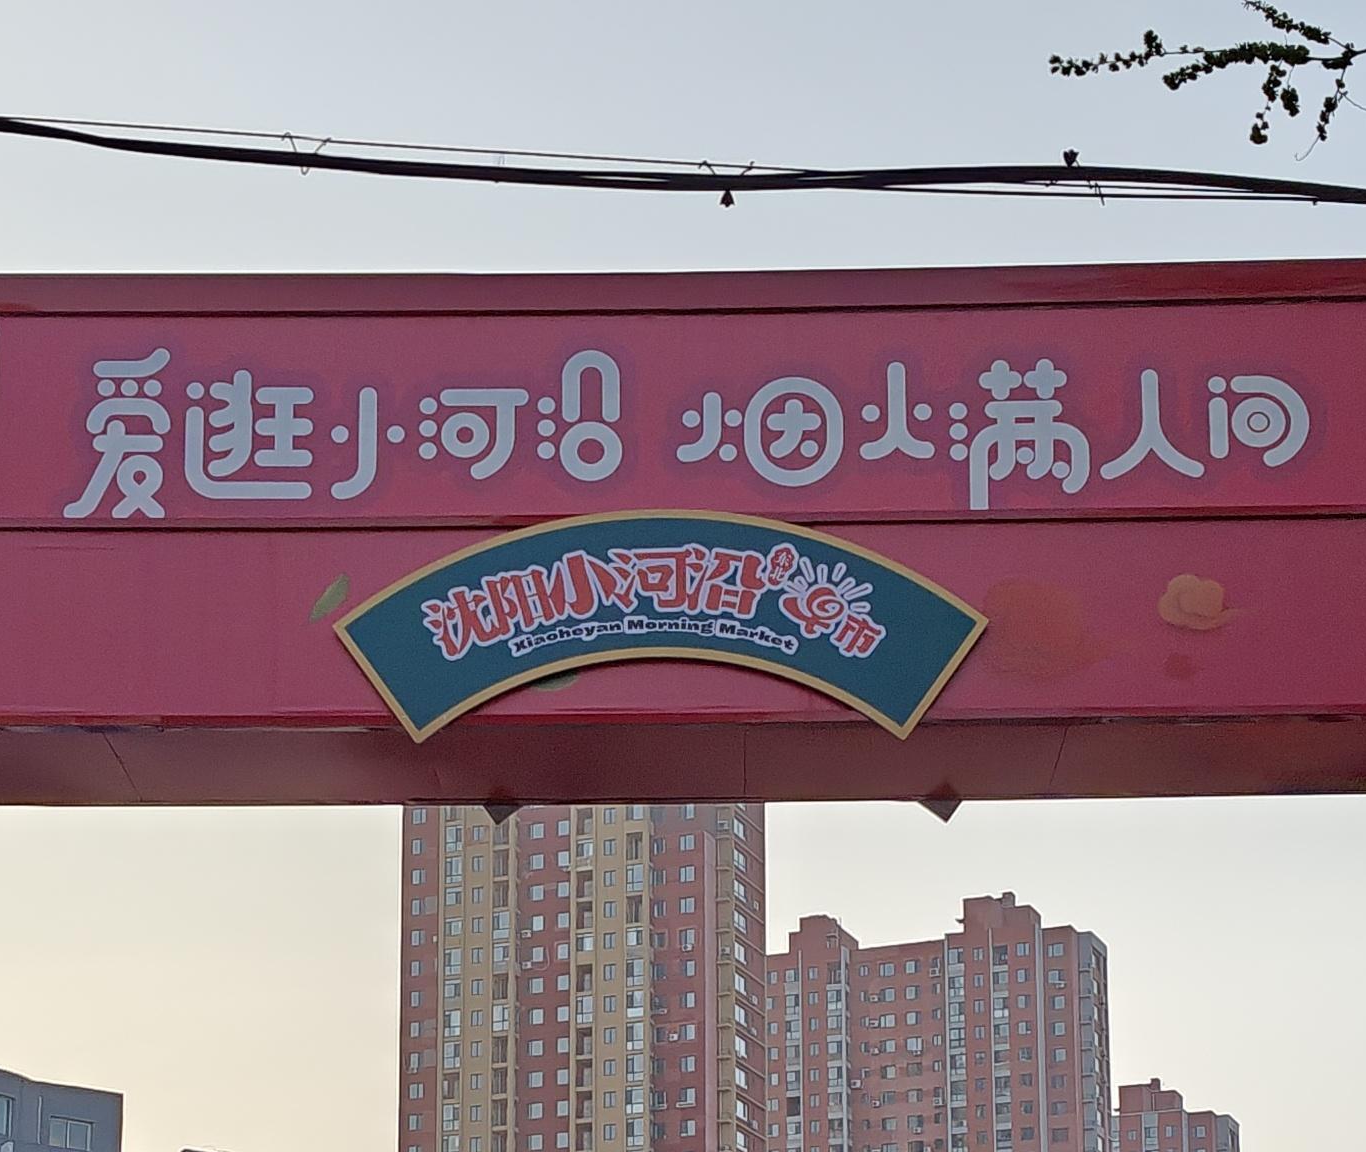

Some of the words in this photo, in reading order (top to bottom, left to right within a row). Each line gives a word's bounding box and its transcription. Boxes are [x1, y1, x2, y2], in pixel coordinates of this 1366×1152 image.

[63, 347, 623, 519] 爱逛小河沿
[676, 358, 1311, 511] 烟火满人间
[511, 622, 622, 653] Xiaoheyan
[627, 617, 716, 635] Morning
[718, 621, 796, 651] Market
